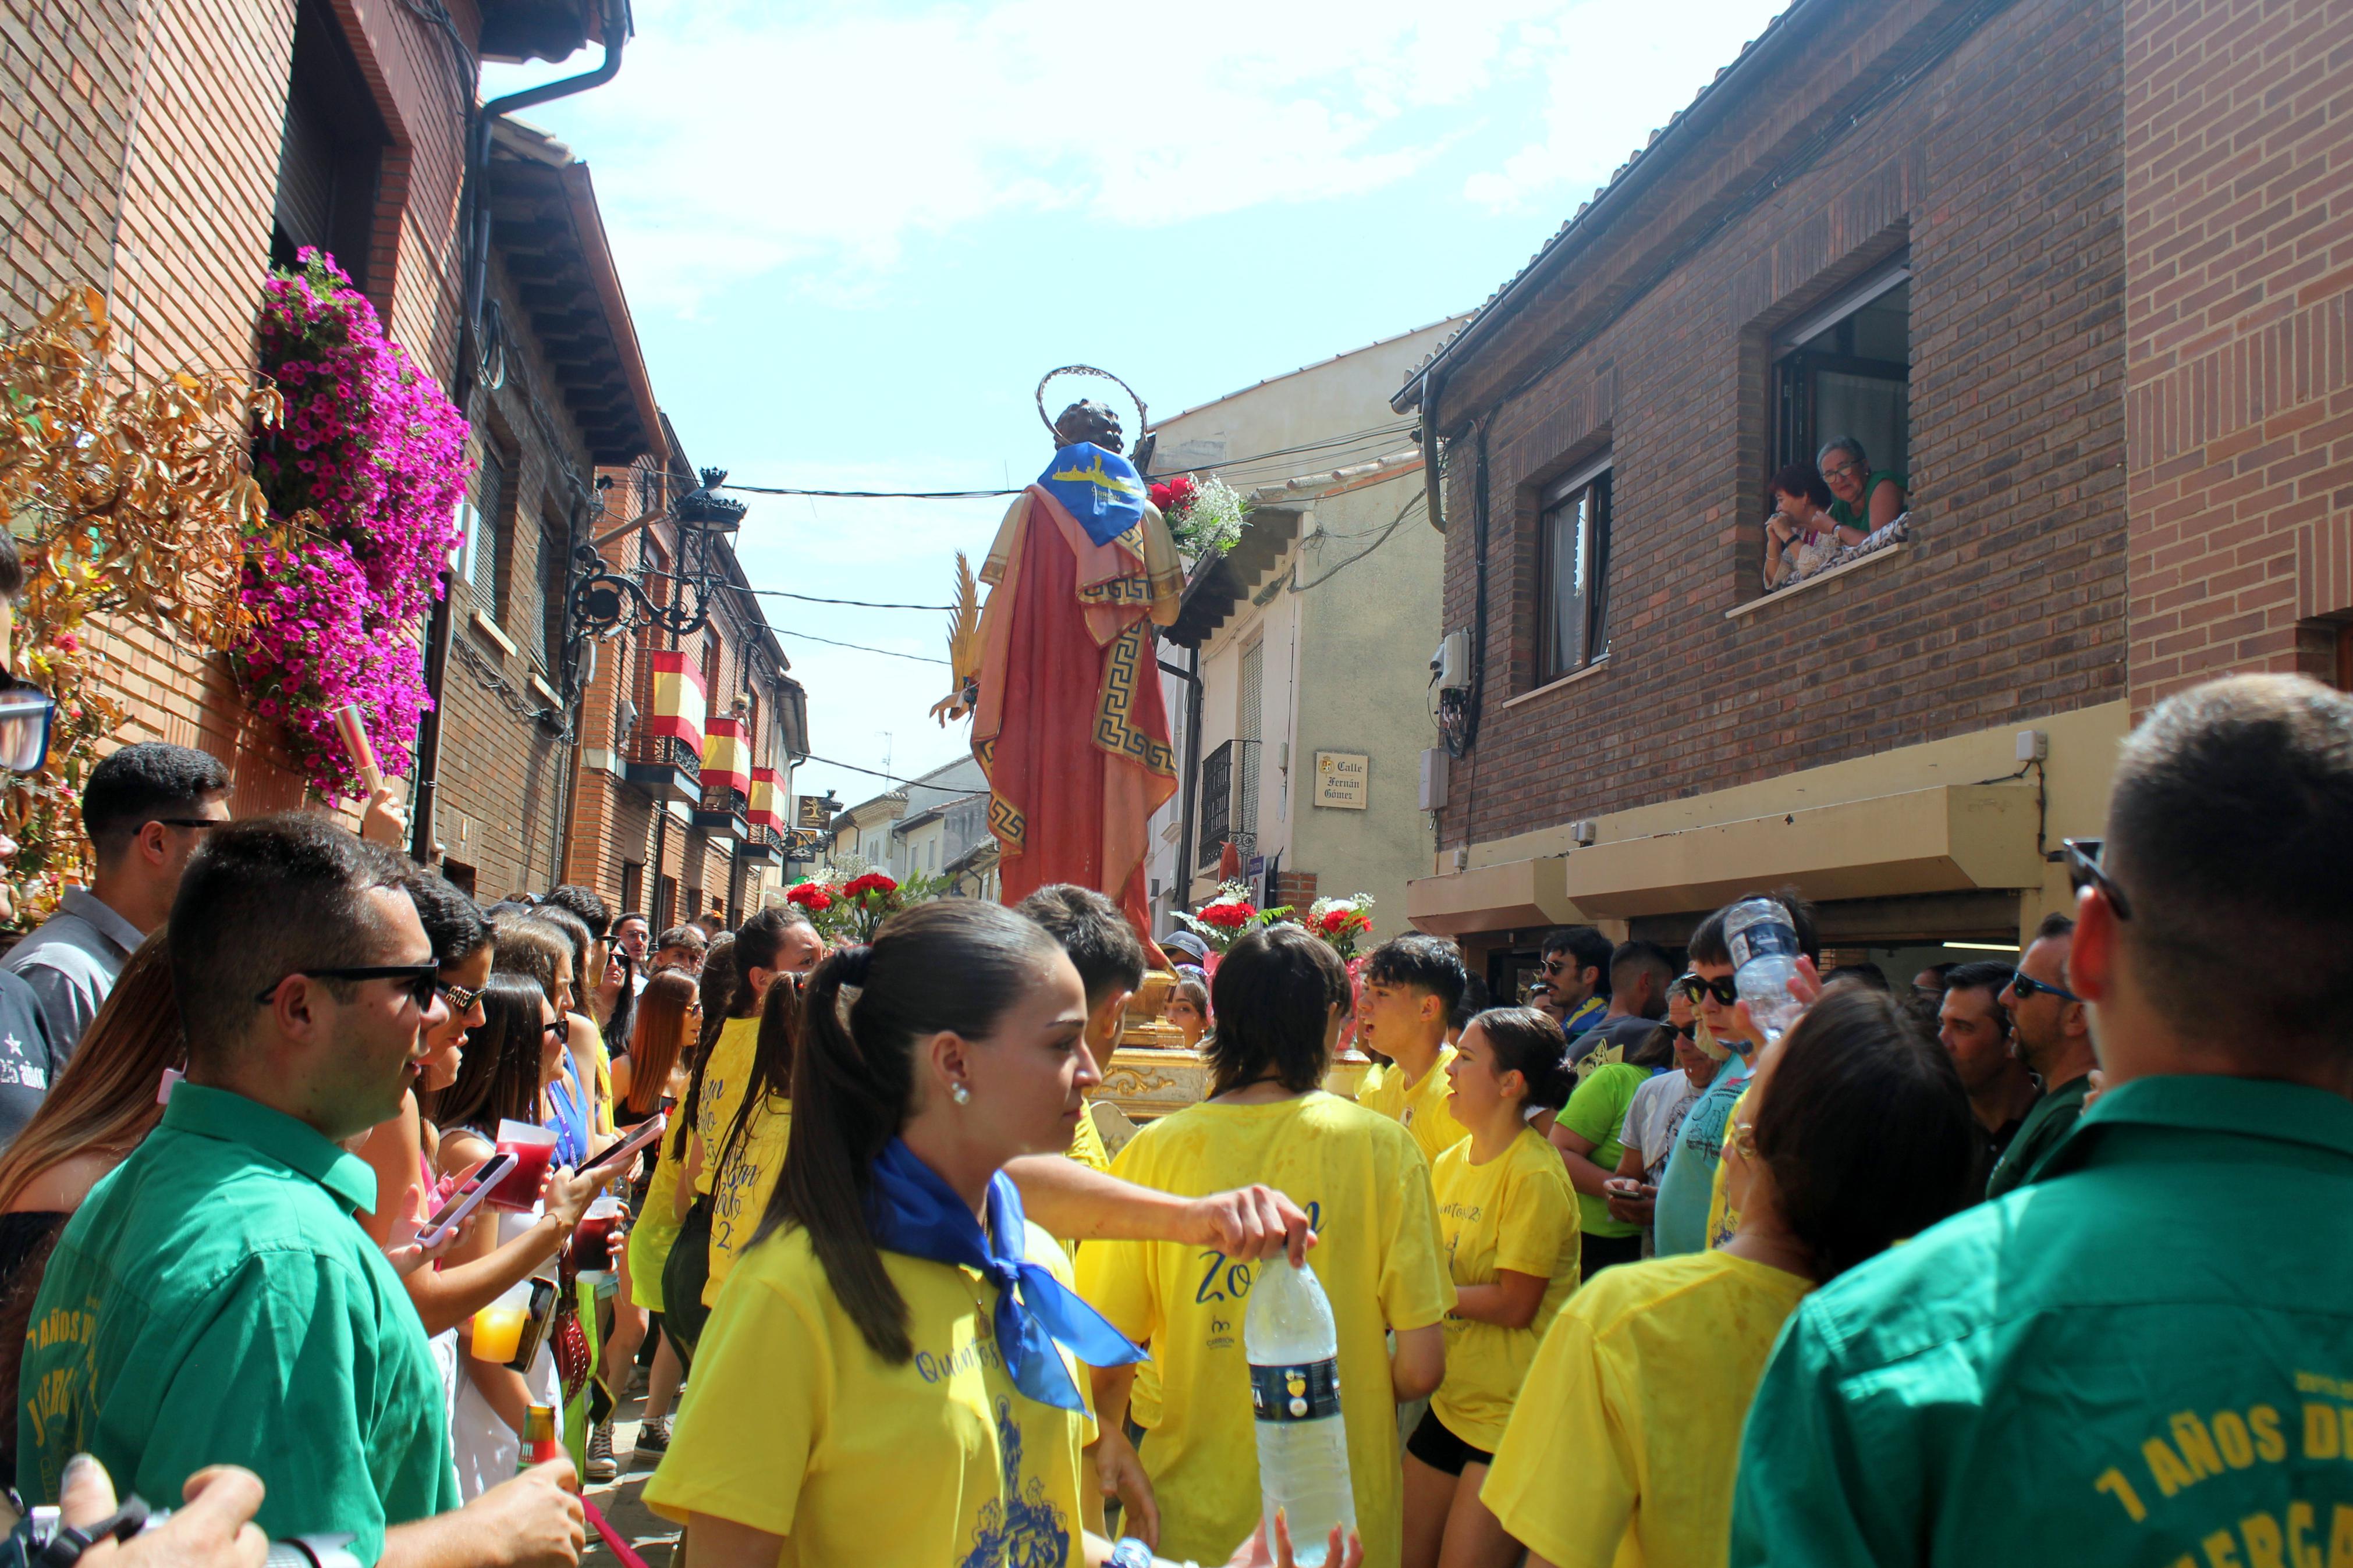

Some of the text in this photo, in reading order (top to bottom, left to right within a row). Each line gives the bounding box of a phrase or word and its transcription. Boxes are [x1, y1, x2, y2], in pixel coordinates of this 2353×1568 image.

[1337, 761, 1362, 773] Calle
[1324, 789, 1353, 799] Gómez
[1327, 777, 1360, 788] Fernán
[40, 1308, 80, 1350] AÑOS
[915, 1337, 999, 1384] Quintos
[2141, 1405, 2287, 1498] AÑOS
